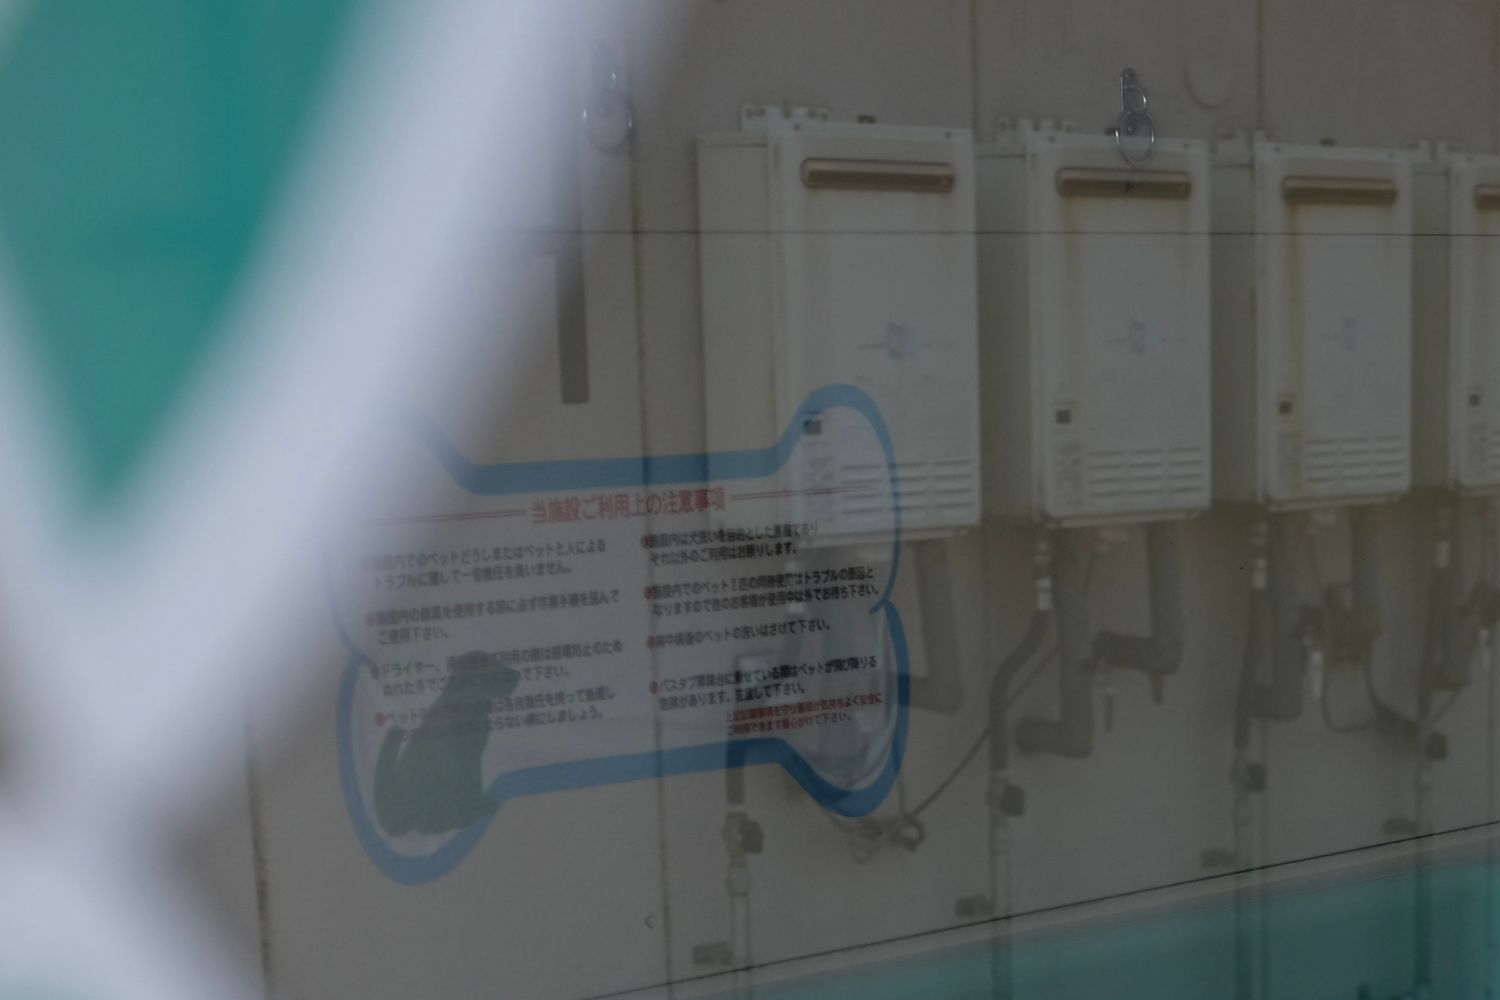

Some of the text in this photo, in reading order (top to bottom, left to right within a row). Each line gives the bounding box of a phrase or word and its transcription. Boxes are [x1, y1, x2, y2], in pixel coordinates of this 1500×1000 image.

[531, 488, 726, 524] 当施設ご利用上の注意事項
